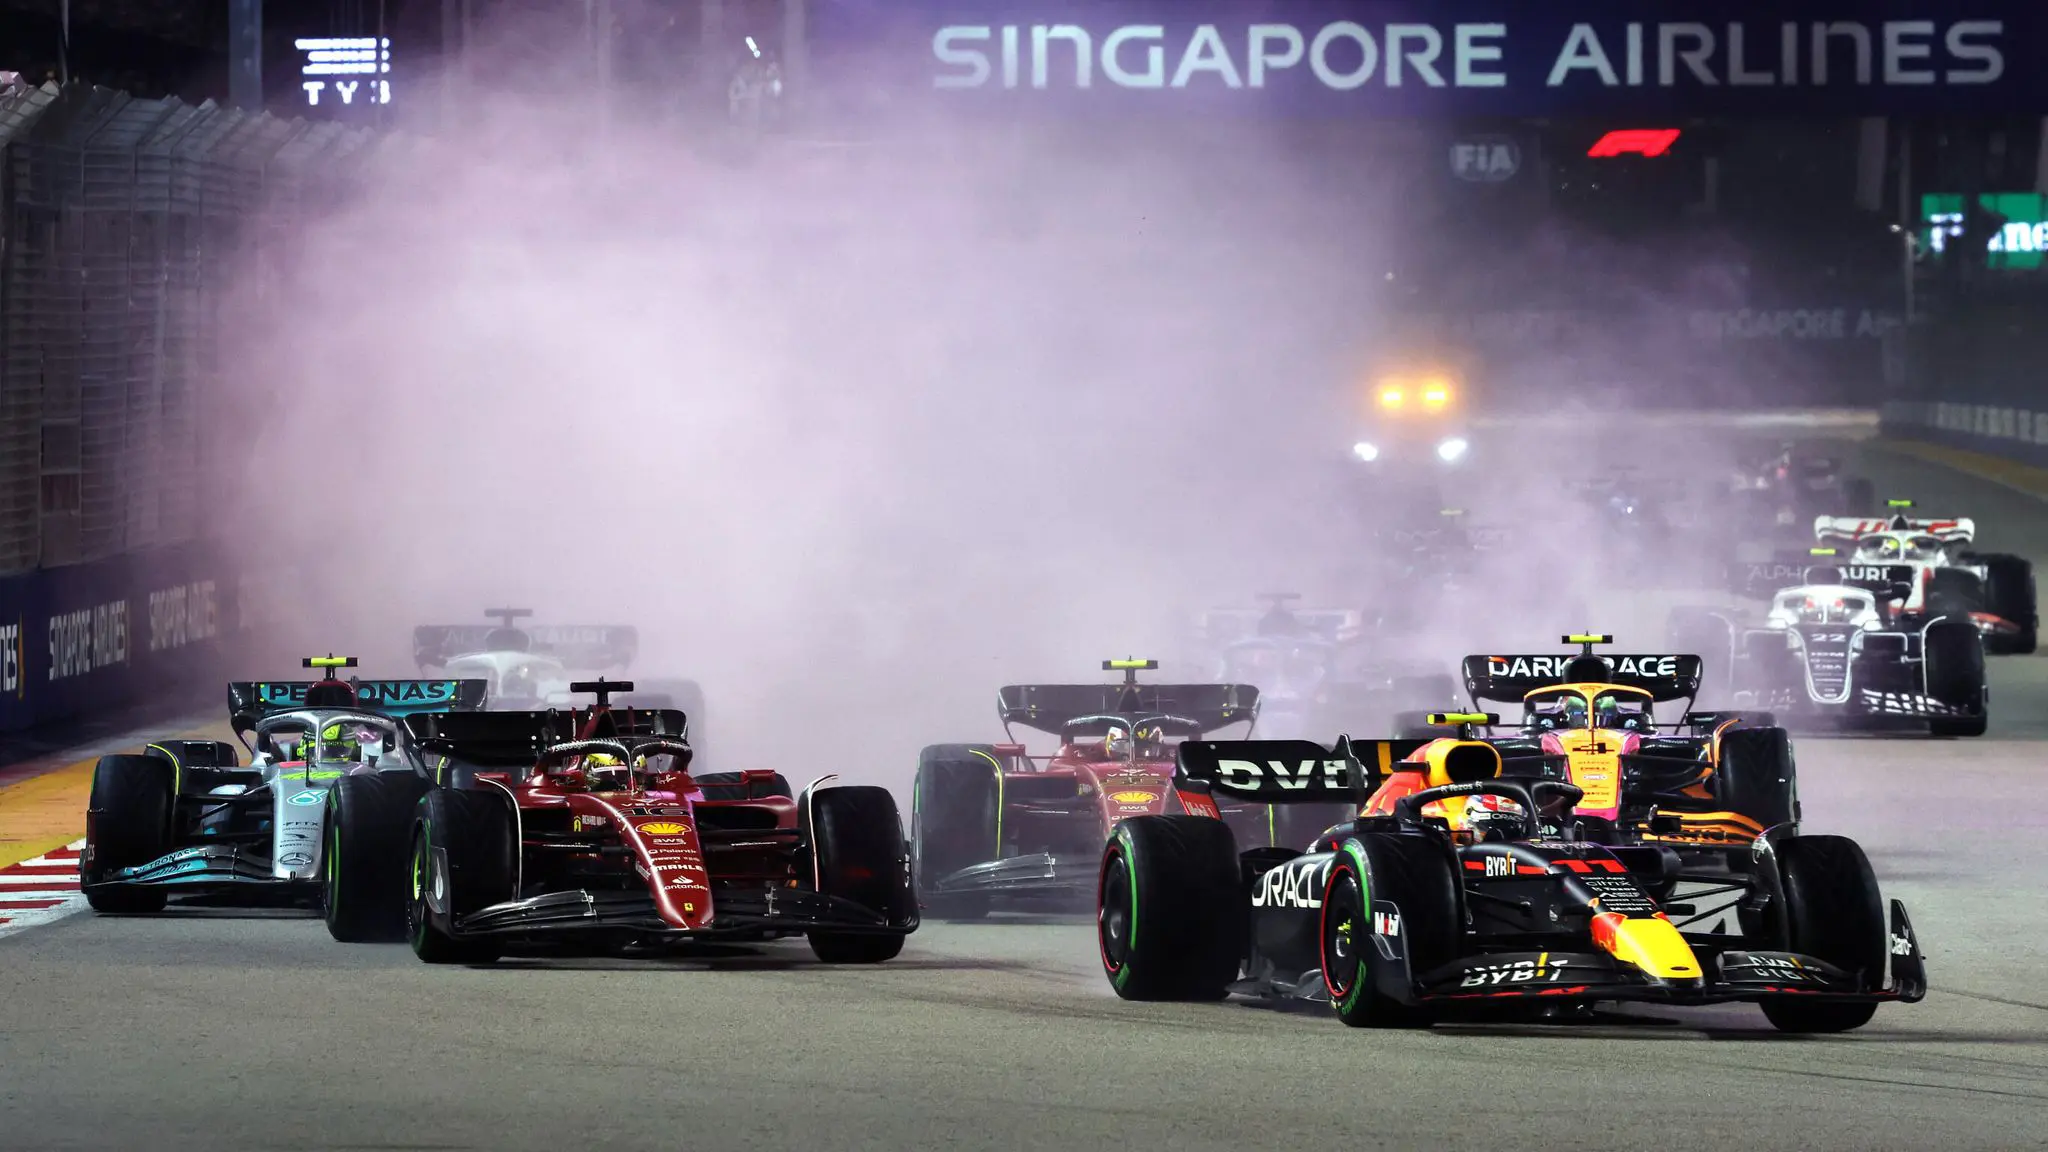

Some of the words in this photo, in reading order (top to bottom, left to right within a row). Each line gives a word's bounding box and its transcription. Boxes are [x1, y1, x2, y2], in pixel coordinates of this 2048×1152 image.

[932, 21, 1508, 89] SINGAPORE
[1546, 20, 2005, 87] AIRLINES
[1811, 633, 1846, 642] 22
[1489, 656, 1677, 679] DARKACE
[269, 681, 447, 701] PEONAS
[1119, 804, 1149, 812] aws
[654, 864, 704, 872] MAHLE
[1485, 851, 1517, 877] BYBIT
